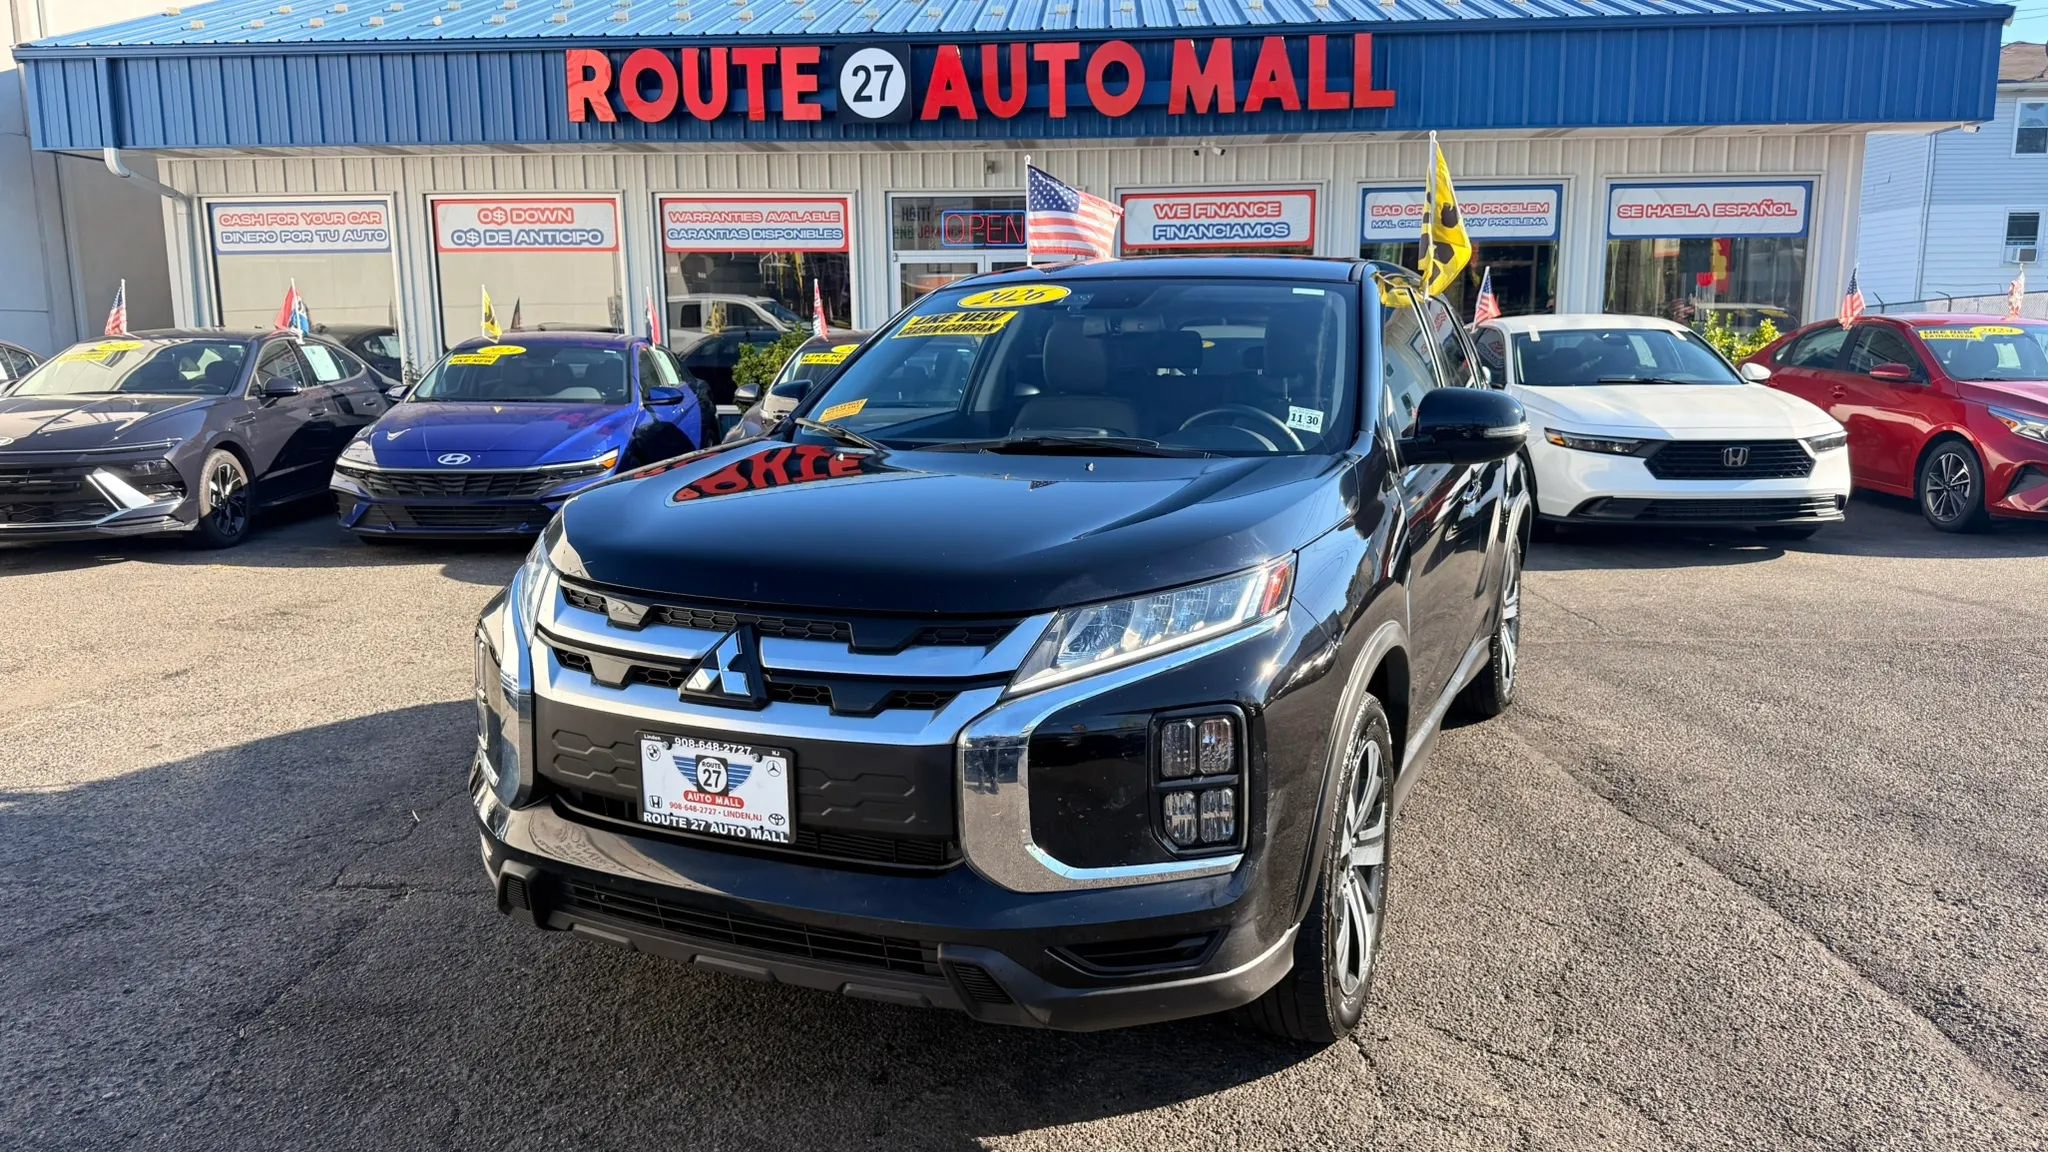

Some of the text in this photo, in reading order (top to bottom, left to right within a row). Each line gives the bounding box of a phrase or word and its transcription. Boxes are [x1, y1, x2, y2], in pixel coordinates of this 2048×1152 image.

[566, 32, 1396, 123] ROUTE 27 AUTO MALL
[1154, 201, 1282, 220] WE FINANCE
[1371, 204, 1402, 217] BAD
[1481, 202, 1549, 214] PROBLEM
[1617, 199, 1797, 218] SE HABLA ESPAÑOL
[220, 211, 382, 227] CASH FOR YOUR CAR
[510, 208, 574, 225] DOWN
[669, 210, 841, 224] WARRANTIES AVAILABLE
[1371, 219, 1396, 229] MAL
[1488, 216, 1547, 227] PROBLEMA
[222, 229, 387, 244] DINERO POR TU AUTO
[667, 228, 843, 241] GARANTIAS DISPONIBLES
[944, 213, 1025, 245] OPEN
[1153, 222, 1290, 241] FINANCIAMOS
[483, 229, 512, 246] DE
[514, 229, 604, 246] ANTICIPO
[973, 288, 1048, 305] 2026
[913, 311, 1009, 326] LIKE NEW
[941, 323, 1004, 334] CARFAX
[1291, 413, 1319, 425] 11 30
[674, 737, 752, 756] 908-648-2727
[702, 761, 722, 769] ROUTE
[702, 768, 722, 788] 27
[687, 793, 741, 808] AUTO MALL
[643, 812, 789, 843] ROUTE 27 AUTO MALL
